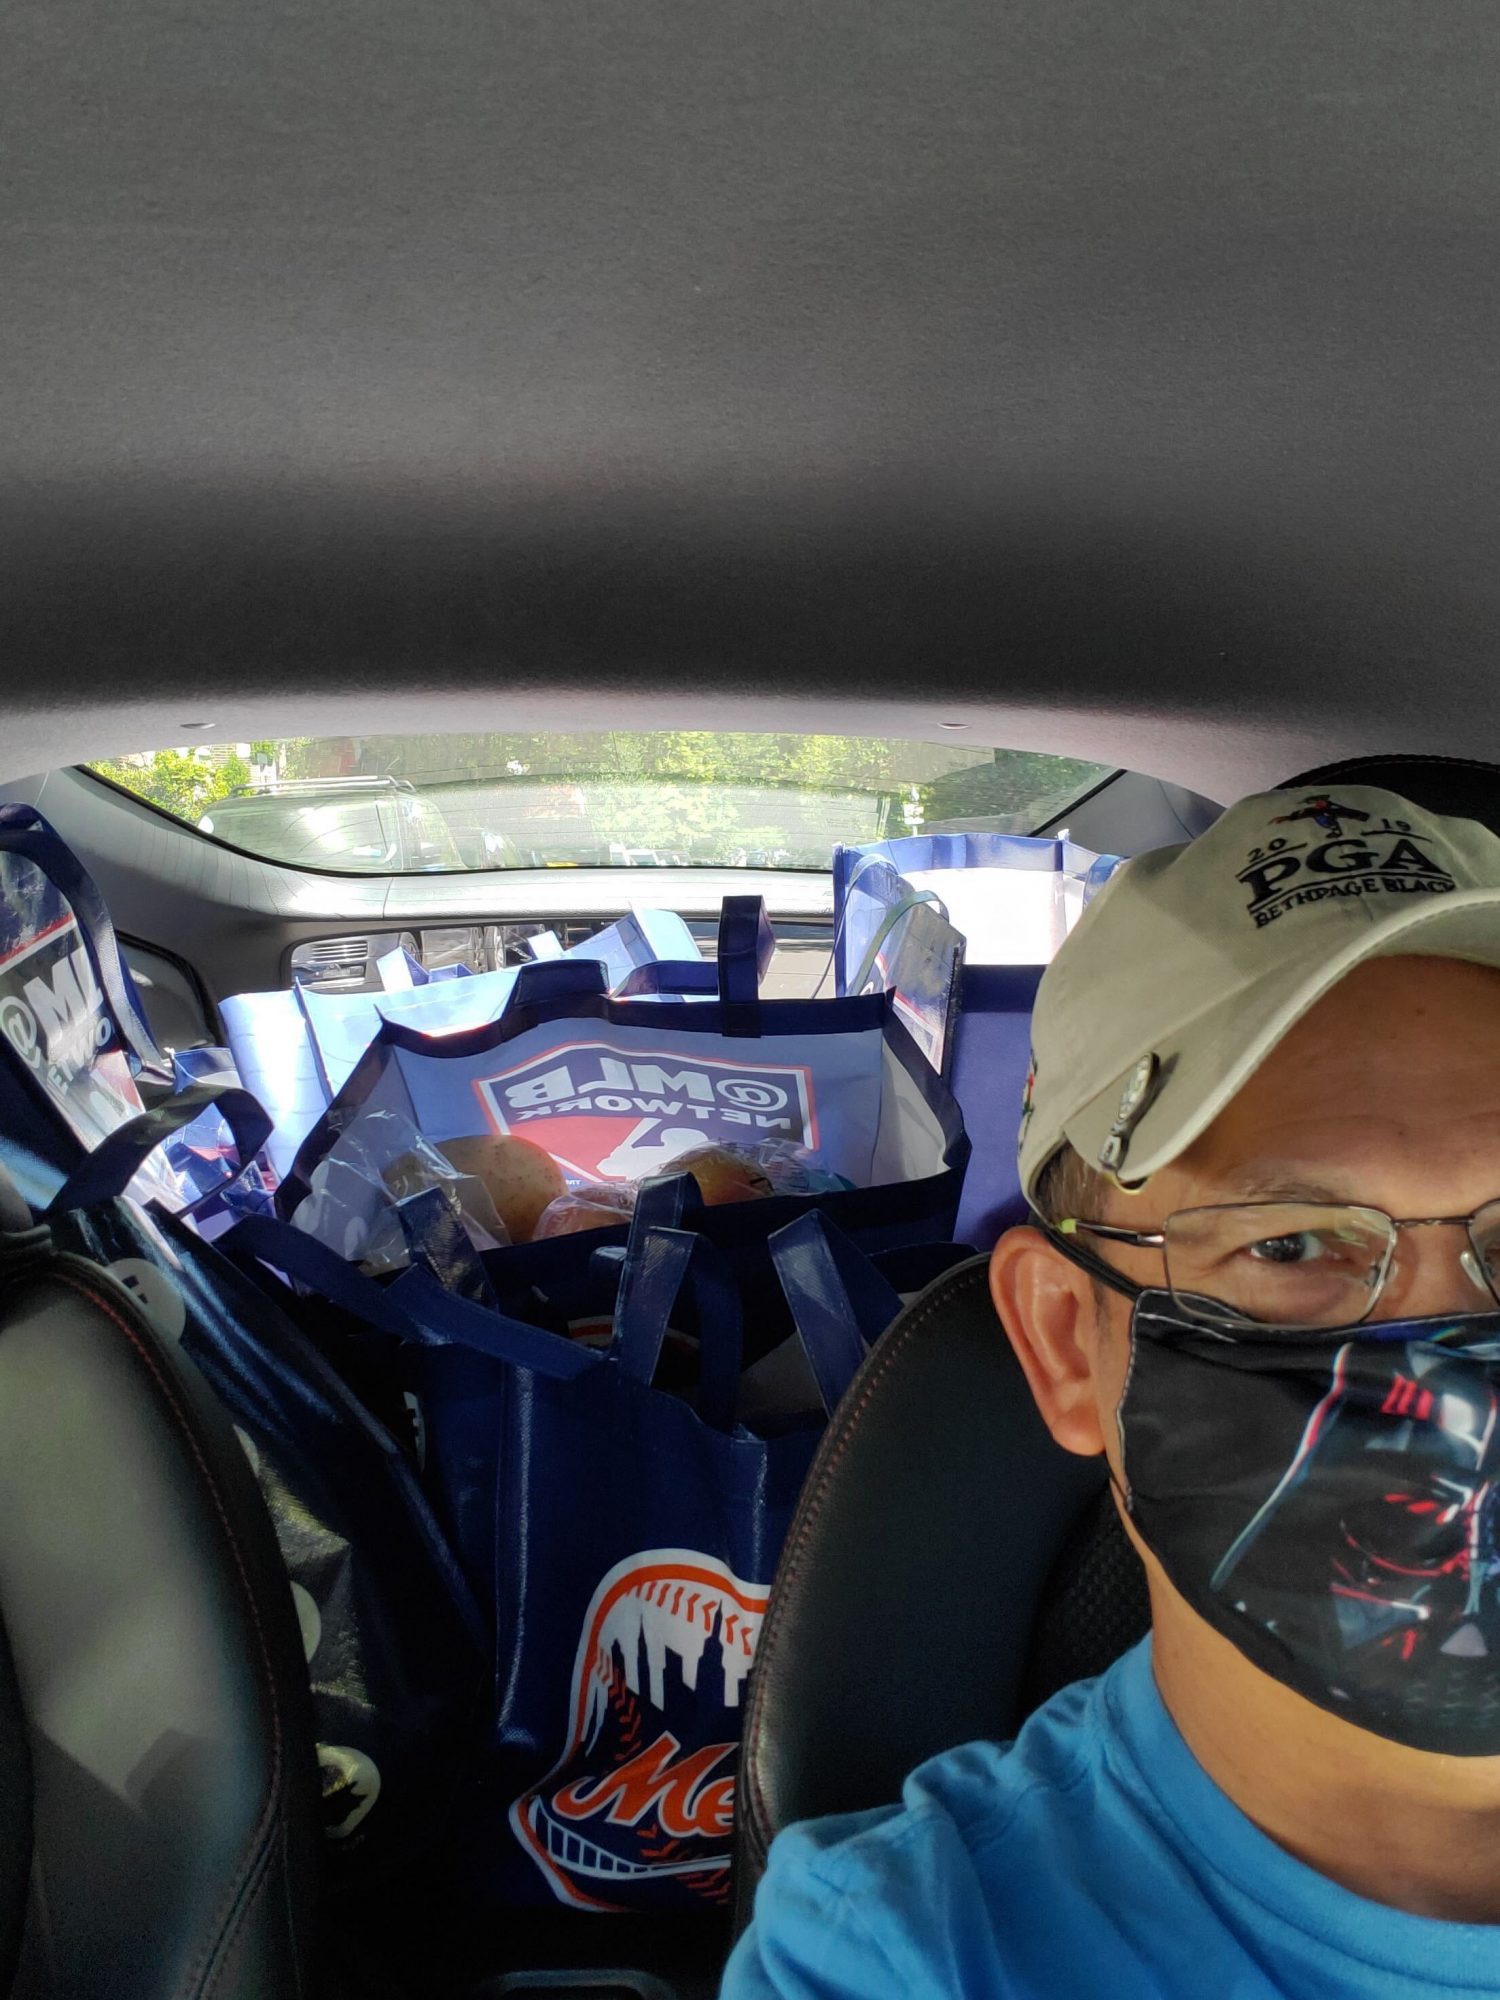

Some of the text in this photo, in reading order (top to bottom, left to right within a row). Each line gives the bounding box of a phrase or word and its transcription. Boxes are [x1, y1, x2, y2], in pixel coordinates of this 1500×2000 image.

[1248, 837, 1287, 862] 20
[1382, 818, 1411, 831] 19
[1239, 839, 1452, 909] PGA
[1254, 877, 1456, 929] BETHPAGE BLACK
[0, 945, 104, 1069] @ML
[552, 1731, 740, 1838] Me
